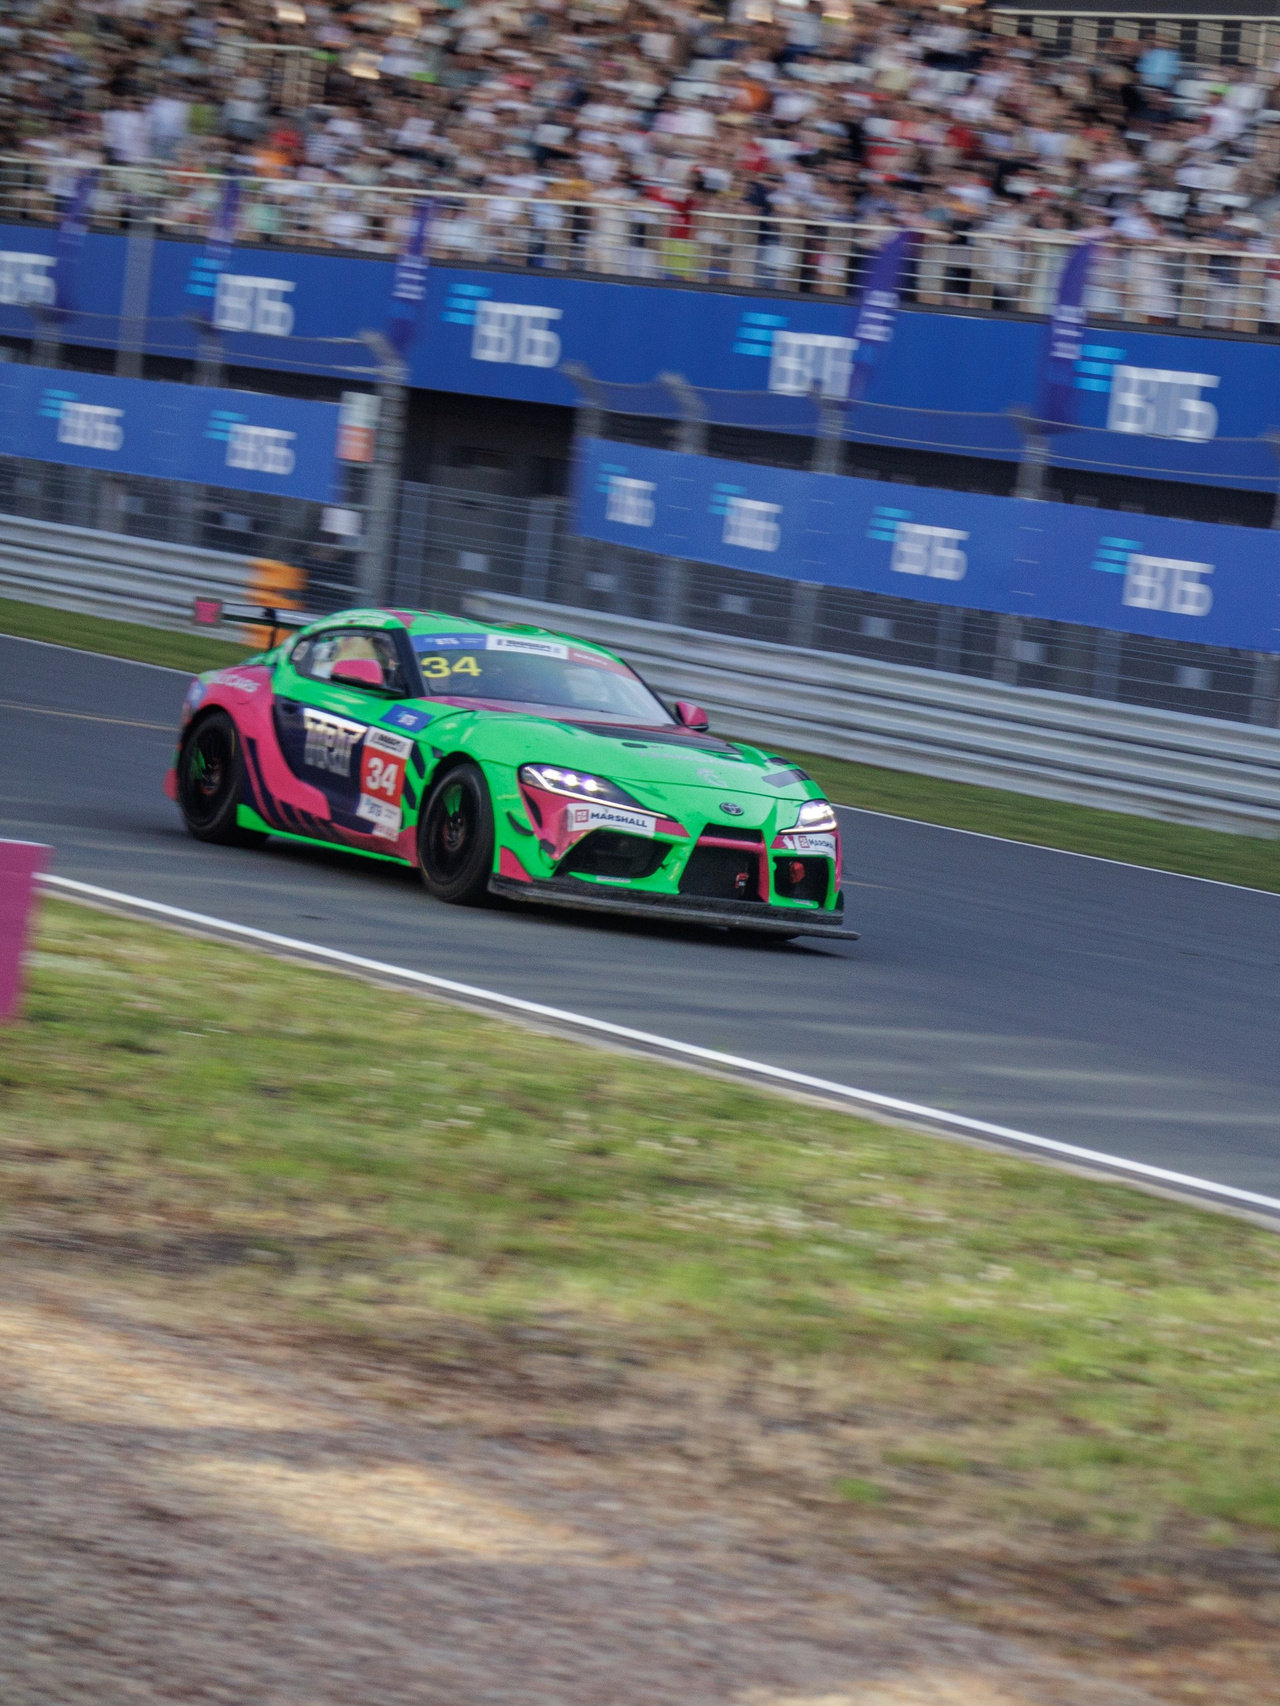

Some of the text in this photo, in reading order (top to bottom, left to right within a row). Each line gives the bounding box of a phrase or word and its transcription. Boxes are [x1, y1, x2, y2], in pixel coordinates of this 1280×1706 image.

[421, 656, 482, 678] 34
[366, 757, 399, 796] 34
[590, 812, 648, 828] MARSHALL
